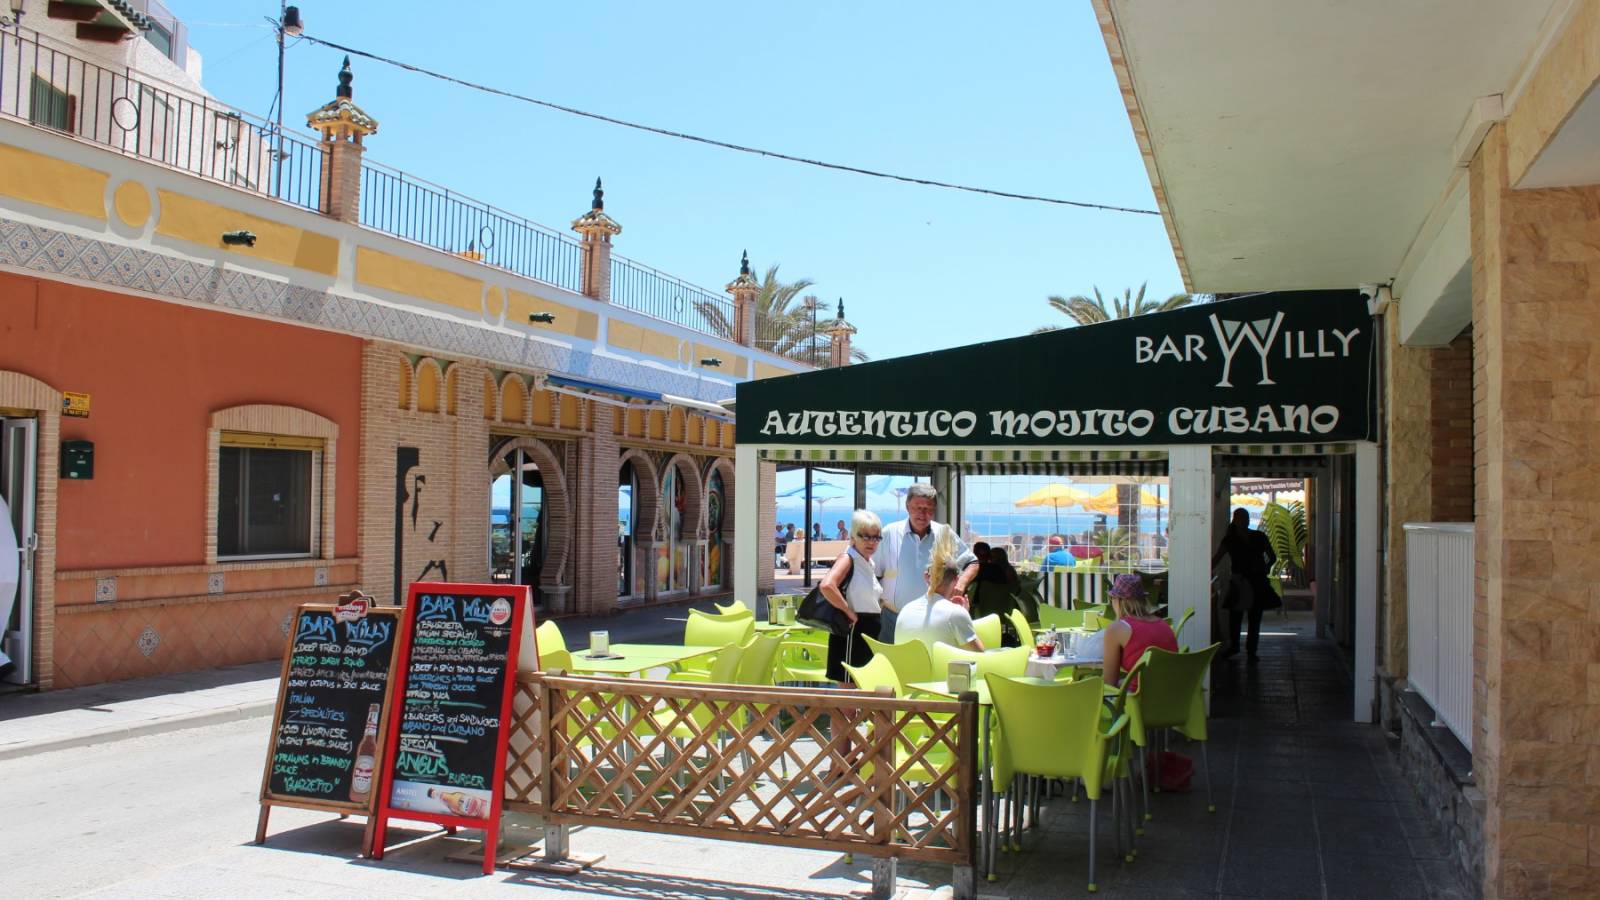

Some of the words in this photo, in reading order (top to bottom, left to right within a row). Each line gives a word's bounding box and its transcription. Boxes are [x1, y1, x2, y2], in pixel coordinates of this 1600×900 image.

[1135, 334, 1208, 364] BAR
[1208, 310, 1361, 388] WILLY
[759, 408, 977, 438] AUTENTICO
[989, 408, 1156, 437] MOJITO
[1168, 403, 1340, 435] CUBANO
[417, 595, 456, 621] BAR
[296, 616, 337, 643] BAR
[344, 618, 391, 647] WILLY
[415, 663, 433, 673] BEEF
[407, 712, 445, 724] BURGERS
[301, 724, 348, 740] LIVORNESE
[447, 721, 485, 737] CUBANO
[400, 737, 443, 752] SPECIAL
[273, 765, 299, 776] SAUCE
[318, 755, 352, 772] BRANDY
[396, 752, 449, 777] ANGUS
[448, 772, 486, 789] BURGER
